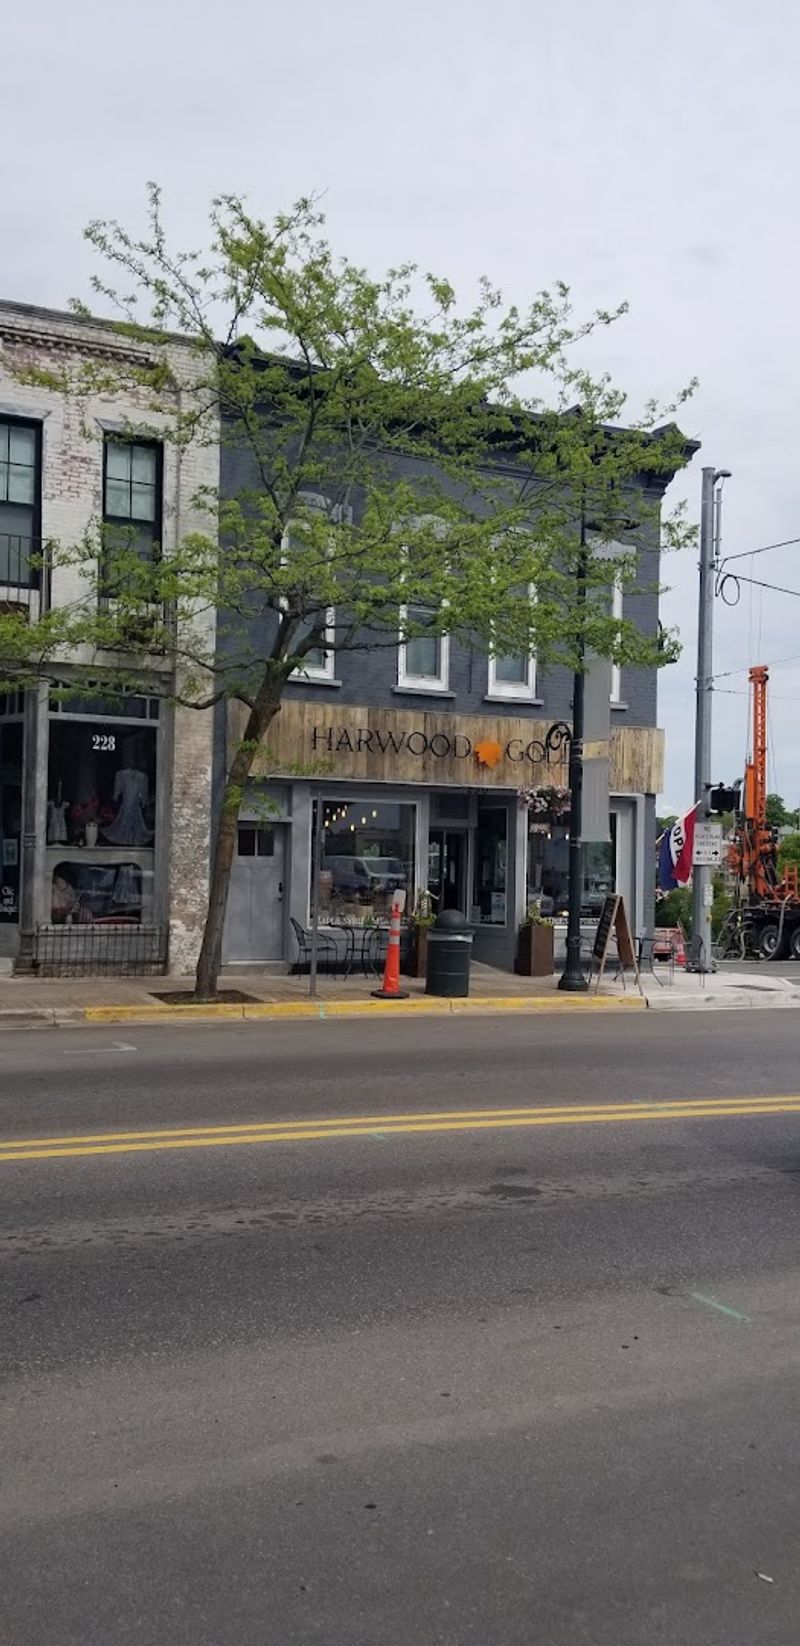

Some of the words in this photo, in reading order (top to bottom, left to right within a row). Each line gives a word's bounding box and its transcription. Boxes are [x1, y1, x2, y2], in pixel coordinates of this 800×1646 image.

[92, 734, 116, 751] 228
[312, 726, 472, 760] HARWOOD
[673, 825, 684, 860] OPE
